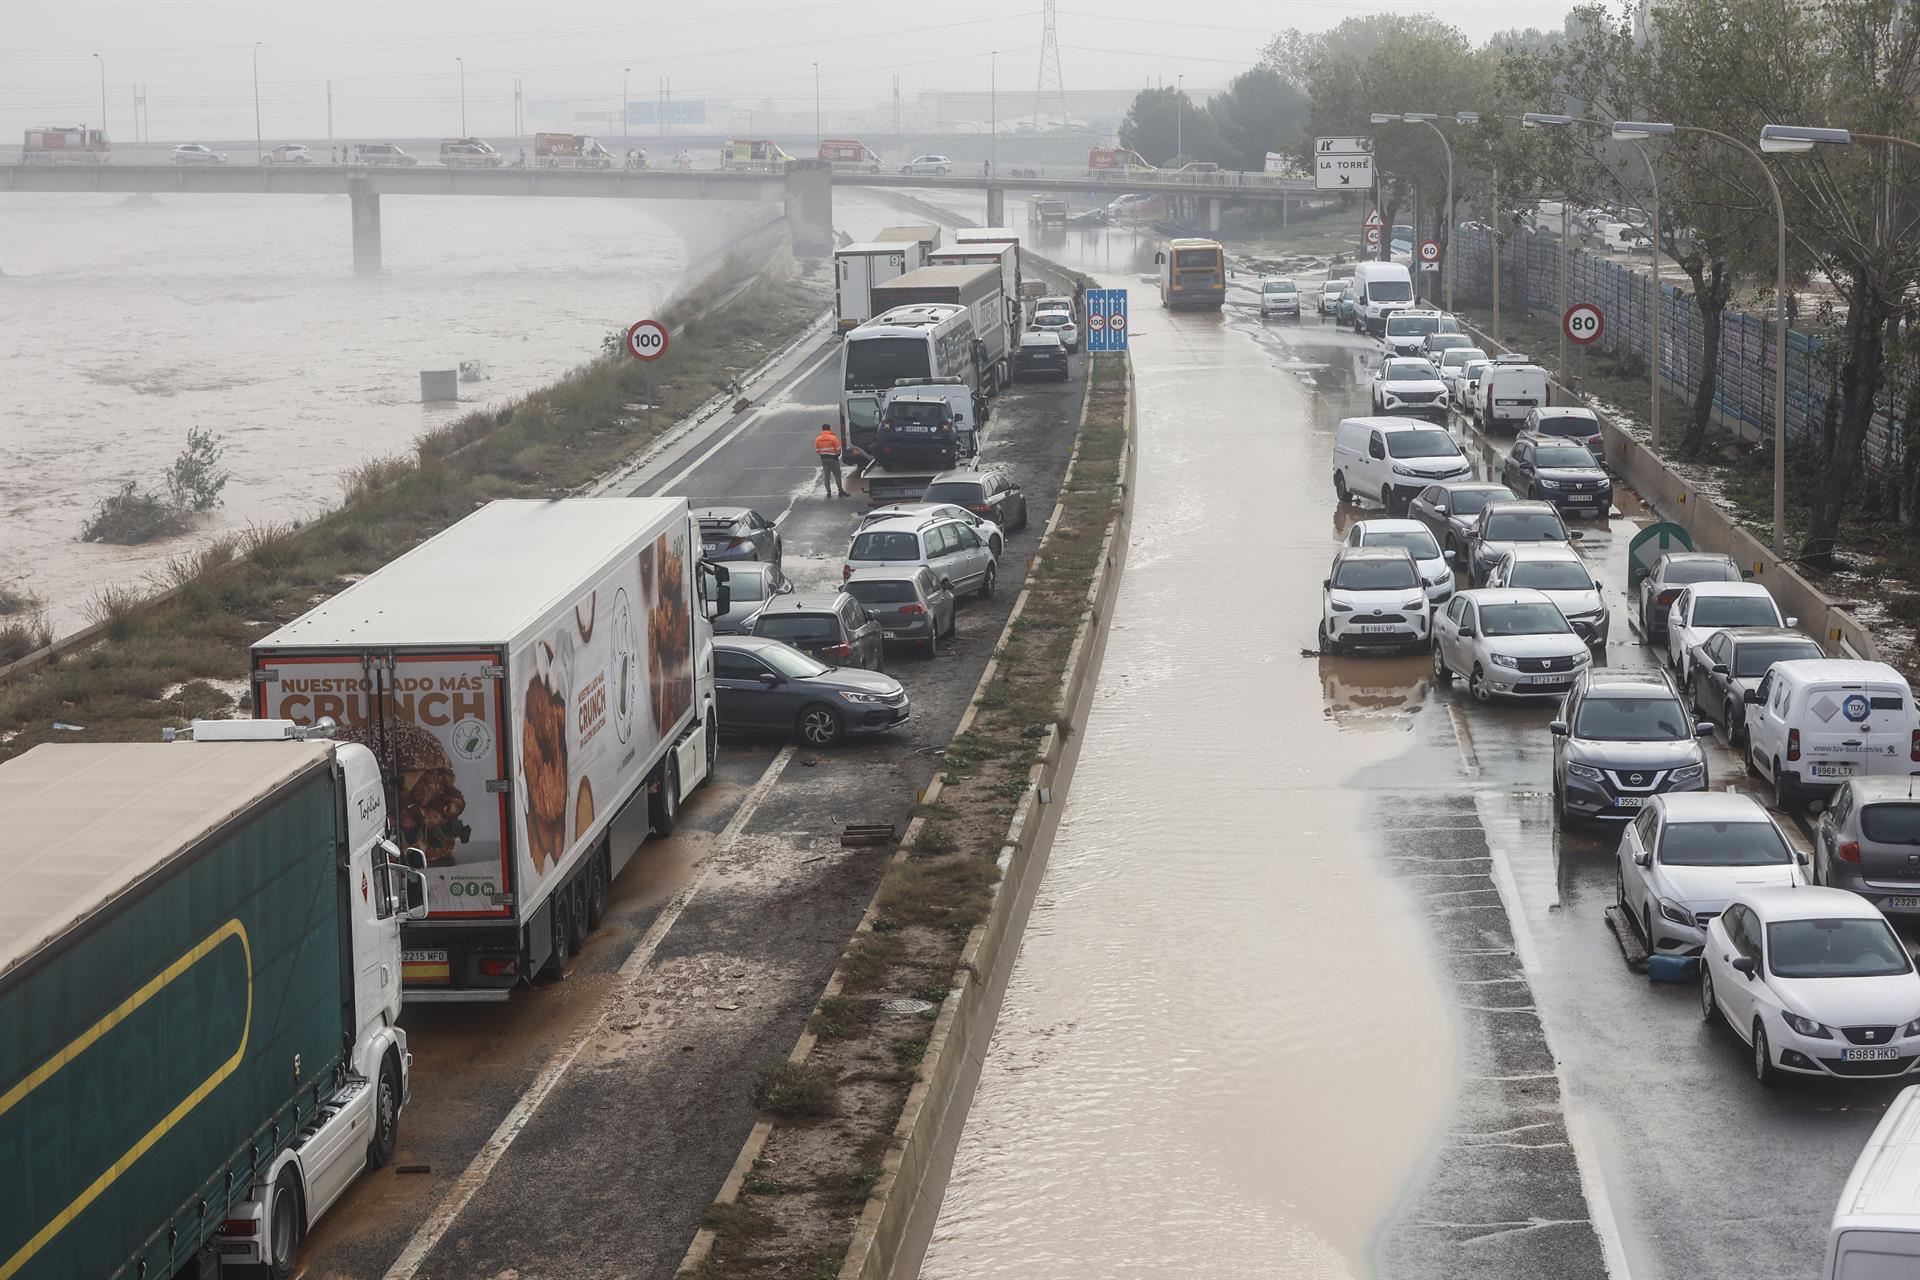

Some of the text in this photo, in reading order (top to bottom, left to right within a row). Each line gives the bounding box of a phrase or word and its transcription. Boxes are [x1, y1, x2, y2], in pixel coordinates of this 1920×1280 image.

[1424, 247, 1436, 255] 60
[890, 256, 899, 266] 9
[1572, 316, 1595, 331] 80
[634, 334, 661, 347] 100
[281, 672, 483, 693] NUESTRO LADO MÁS
[279, 691, 486, 727] CRUNCH
[578, 684, 606, 734] CRUNCH
[1817, 767, 1853, 775] 9968 LTX
[1620, 798, 1638, 806] 3552
[403, 952, 425, 960] 2215
[1849, 1049, 1896, 1059] 6989 HKD
